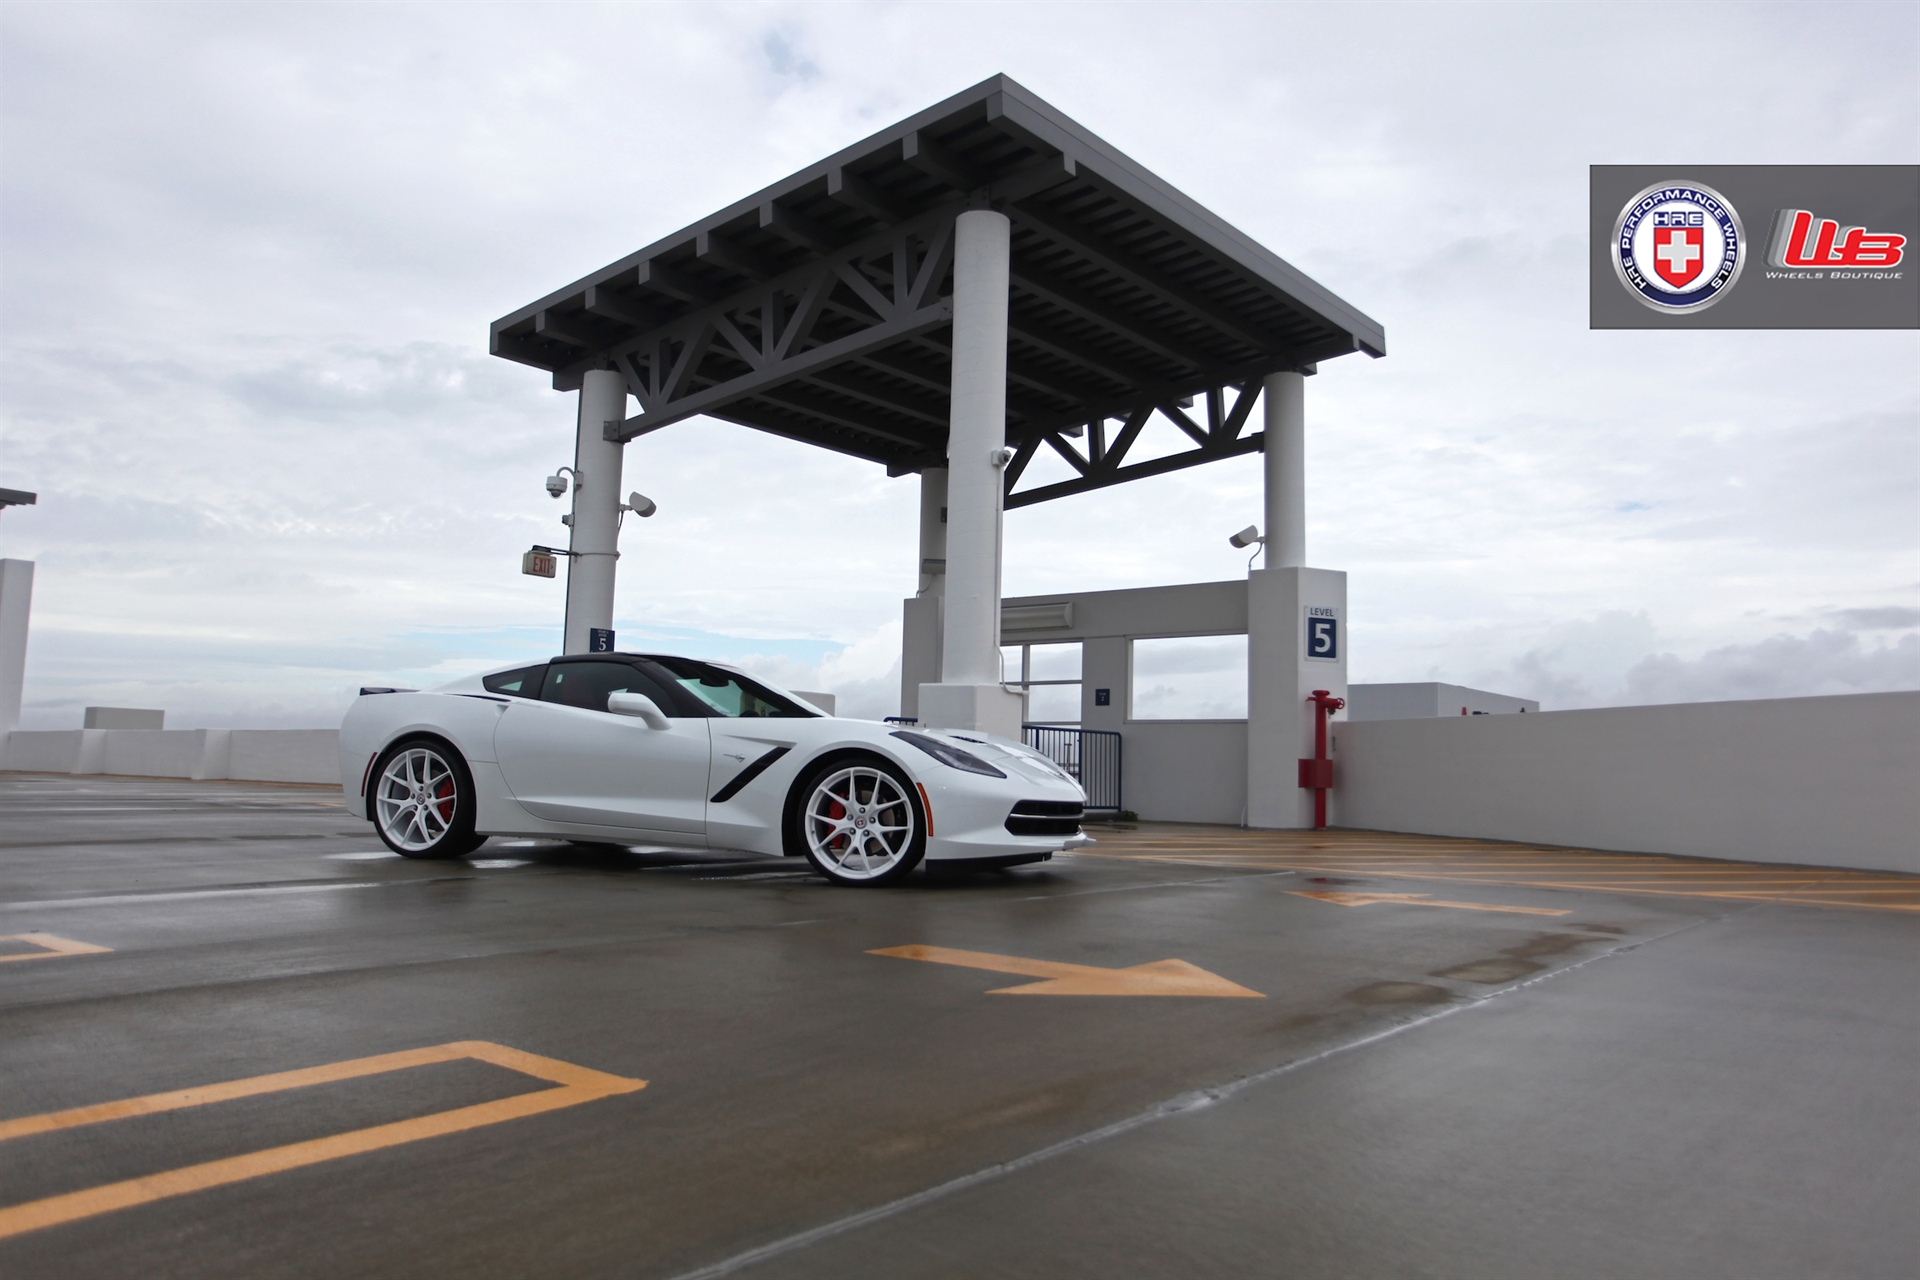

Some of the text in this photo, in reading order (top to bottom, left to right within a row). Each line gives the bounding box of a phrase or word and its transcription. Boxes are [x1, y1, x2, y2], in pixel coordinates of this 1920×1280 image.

[532, 556, 551, 575] EXIT
[1310, 607, 1334, 617] LEVEL
[598, 637, 607, 651] 5
[1314, 623, 1331, 653] 5
